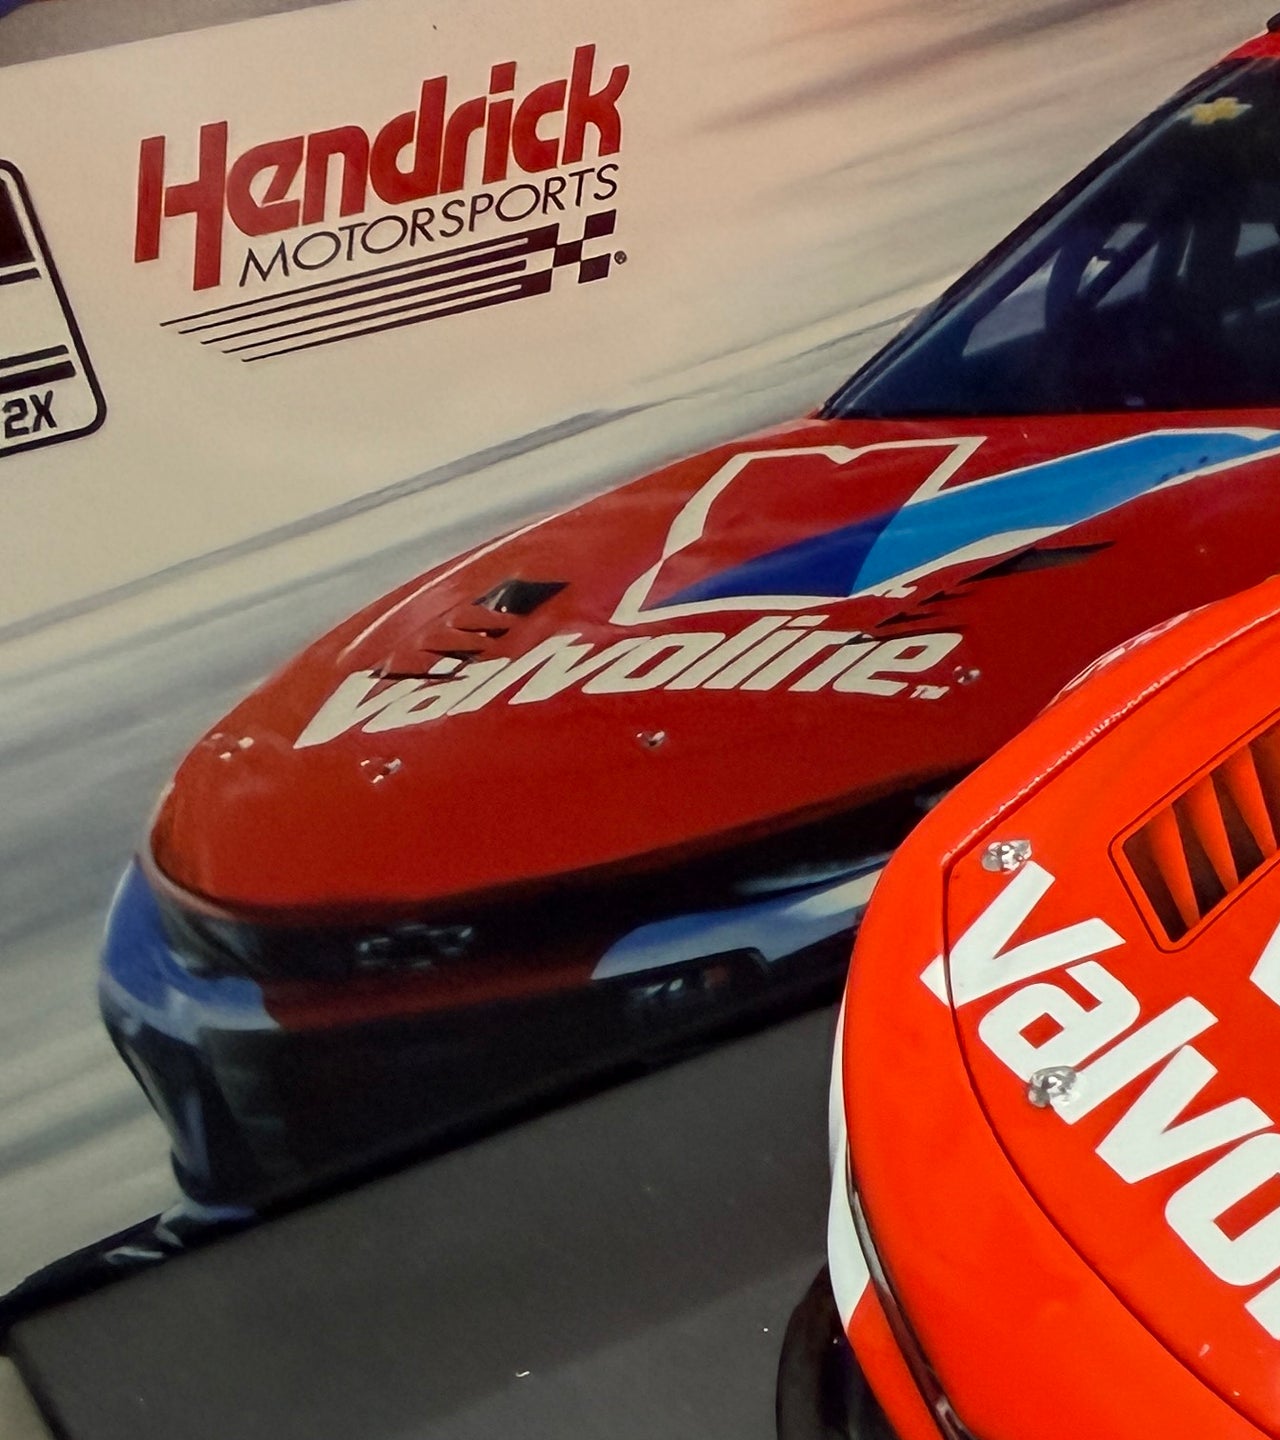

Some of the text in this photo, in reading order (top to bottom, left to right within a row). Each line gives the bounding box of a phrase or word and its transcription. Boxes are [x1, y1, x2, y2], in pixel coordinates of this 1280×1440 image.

[134, 44, 630, 291] Hendrick
[239, 164, 619, 288] MOTORSPORTS
[2, 390, 58, 439] 2X
[293, 614, 964, 749] Valvoline
